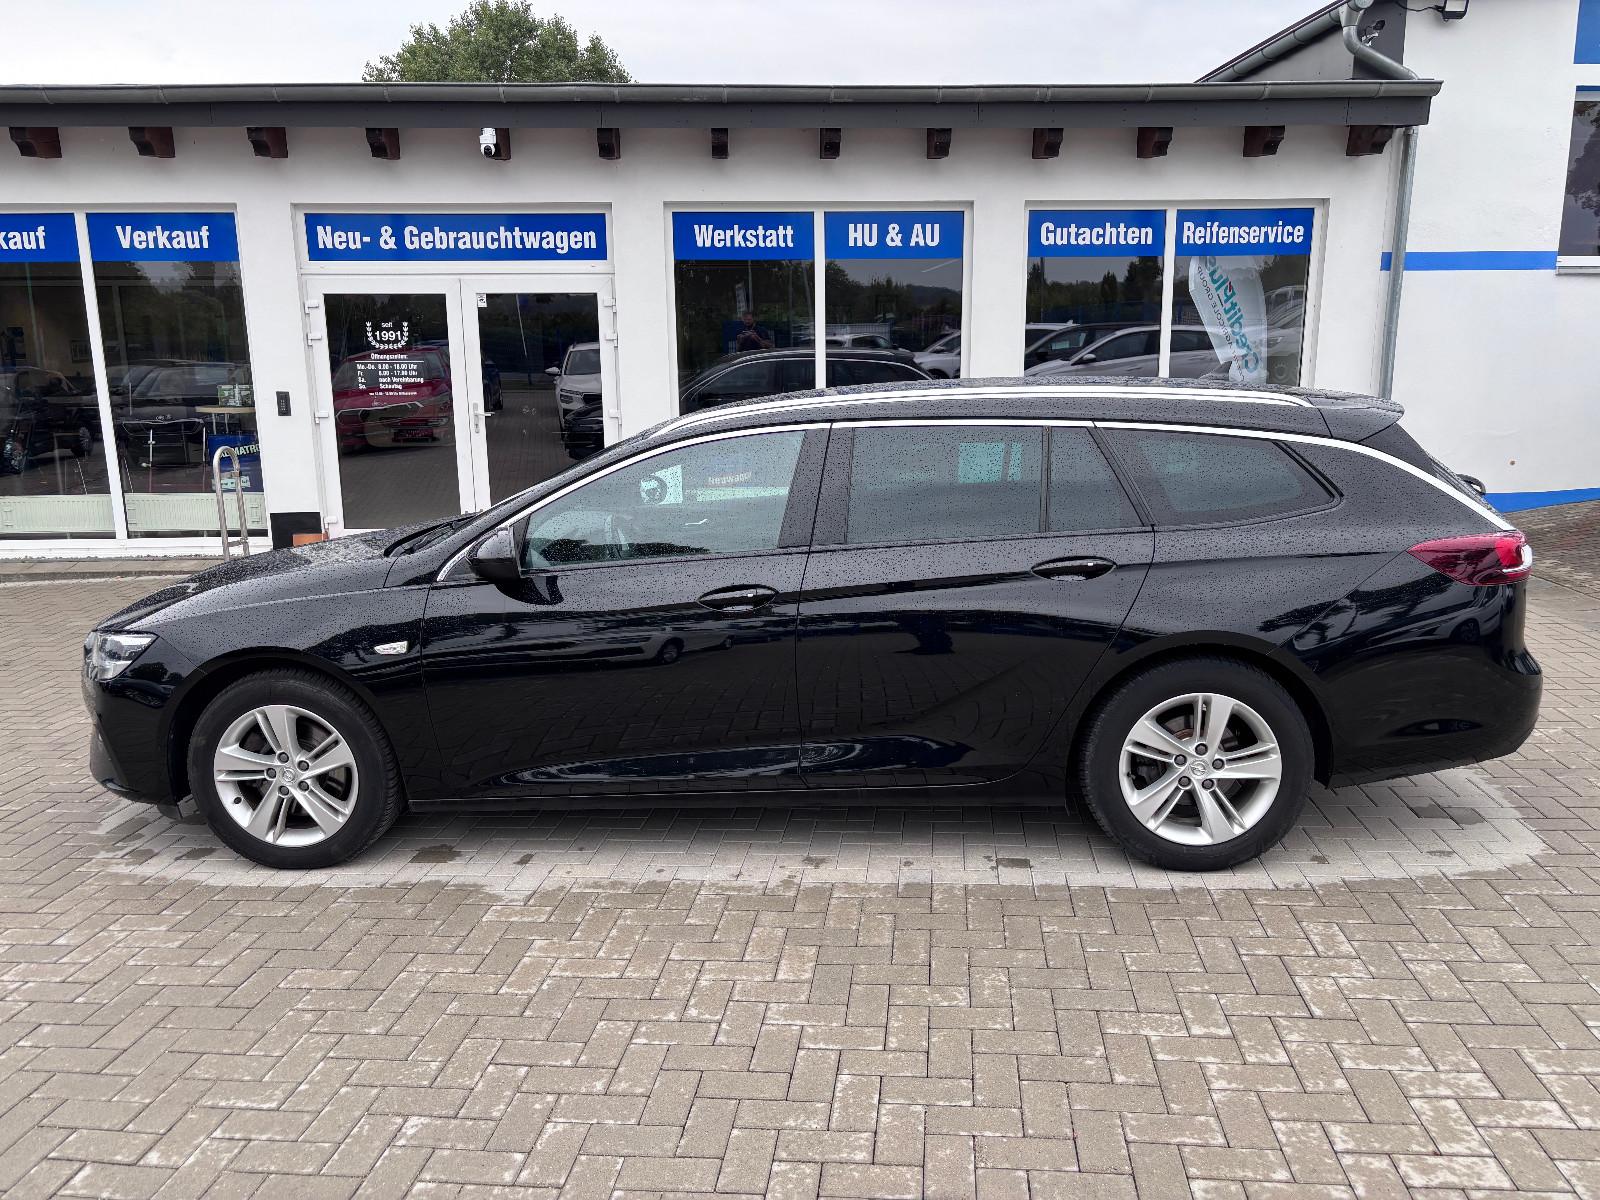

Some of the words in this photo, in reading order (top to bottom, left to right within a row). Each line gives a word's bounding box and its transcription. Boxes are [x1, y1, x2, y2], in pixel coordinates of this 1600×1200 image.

[115, 225, 209, 249] Verkauf
[316, 226, 371, 249] Neu-
[379, 225, 398, 250] &
[404, 225, 597, 254] Gebrauchtwagen
[693, 224, 794, 248] Werkstatt
[848, 223, 878, 247] HU
[885, 223, 903, 247] &
[910, 223, 940, 247] AU
[1040, 222, 1153, 246] Gutachten
[1182, 220, 1305, 245] Reifenservice
[374, 330, 402, 341] 1991
